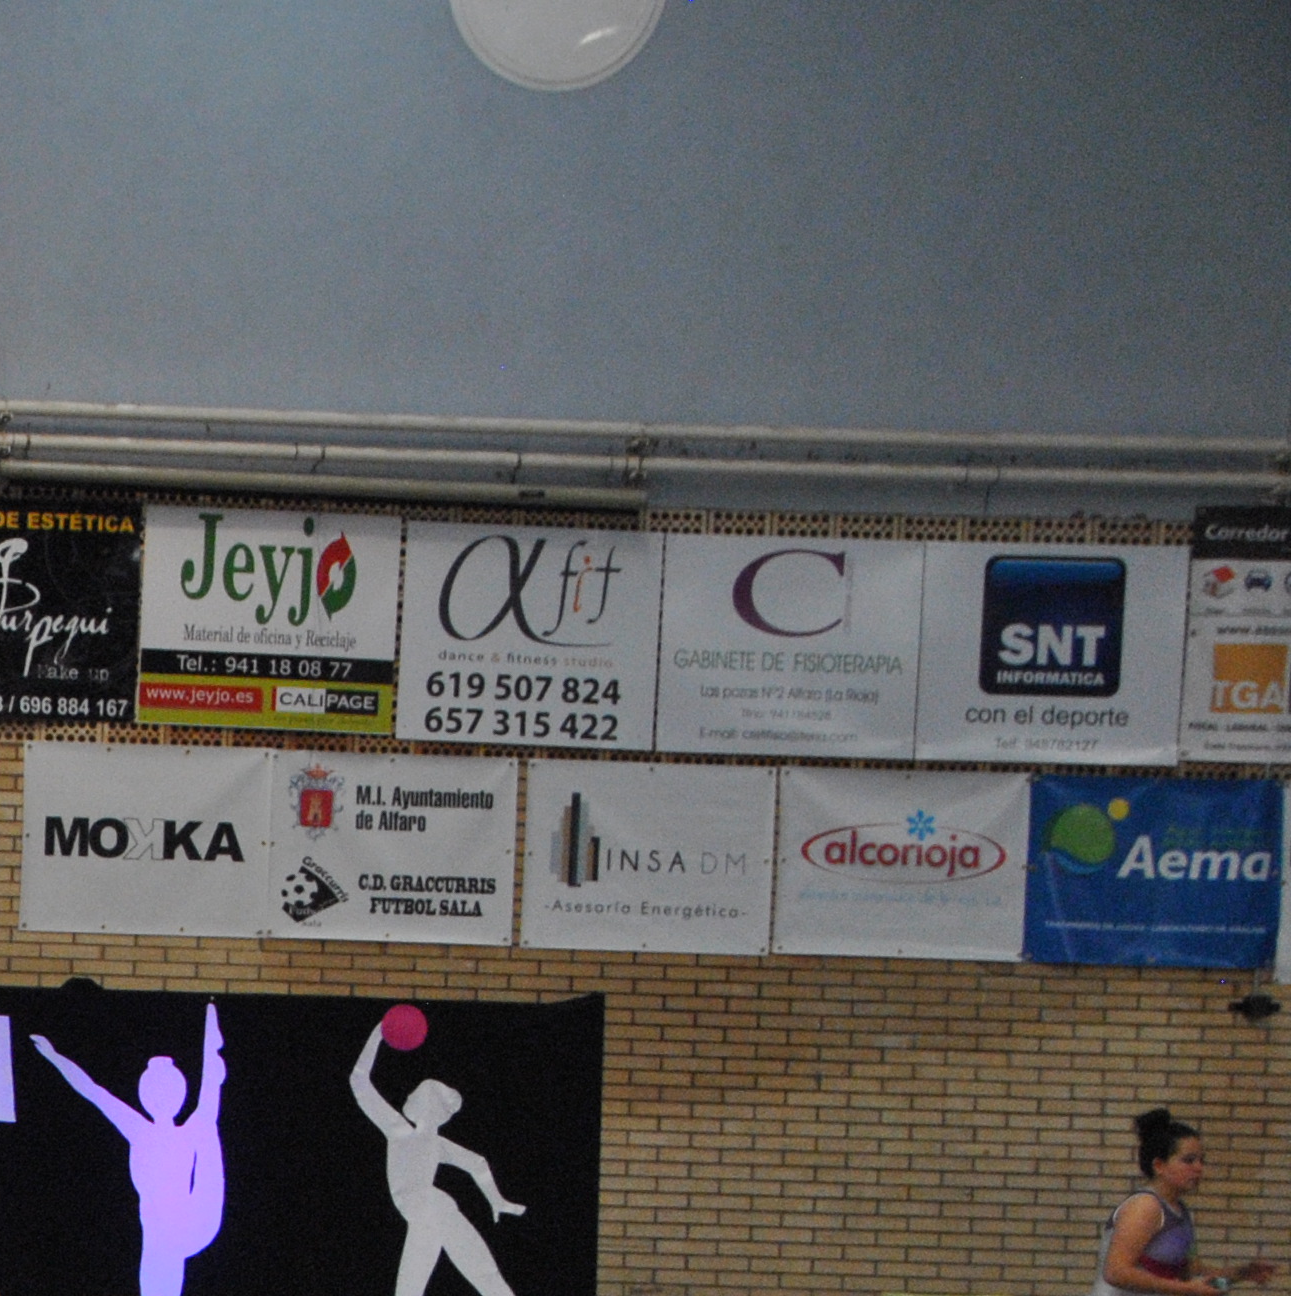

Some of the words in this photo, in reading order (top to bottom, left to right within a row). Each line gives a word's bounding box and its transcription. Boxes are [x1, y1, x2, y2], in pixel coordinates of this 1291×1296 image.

[27, 506, 135, 533] ESTÉTICA
[181, 512, 357, 627] Jeyjo
[183, 623, 235, 643] Material
[237, 625, 252, 644] de
[253, 626, 293, 647] oficina
[295, 633, 302, 650] y
[305, 629, 358, 653] Reciclaje
[999, 622, 1106, 667] SNT
[177, 655, 217, 672] Tel.:
[225, 657, 259, 674] 941
[270, 659, 291, 675] 18
[298, 660, 321, 676] 08
[330, 662, 352, 678] 77
[437, 649, 485, 663] dance
[490, 652, 501, 664] &
[506, 651, 558, 667] fitness
[564, 656, 614, 669] studio
[672, 648, 756, 672] GABINETE
[761, 651, 785, 672] DE
[793, 651, 904, 676] FISIOTERAPIA
[88, 668, 110, 682] up
[426, 671, 486, 699] 619
[494, 673, 554, 703] 507
[560, 675, 622, 706] 824
[996, 671, 1104, 685] INFORMATICA
[19, 696, 53, 714] 696
[57, 698, 90, 716] 884
[96, 698, 128, 717] 167
[145, 686, 254, 705] www.jeyjo.es
[1211, 680, 1285, 709] TGA
[424, 706, 484, 735] 657
[492, 708, 552, 739] 315
[559, 712, 619, 742] 422
[964, 706, 1007, 725] con
[1013, 704, 1035, 726] el
[1040, 704, 1130, 731] deporte
[355, 785, 387, 806] M.I.
[391, 786, 494, 810] Ayuntamiento
[355, 810, 373, 831] de
[378, 810, 427, 832] Alfaro
[606, 848, 687, 873] INSA
[700, 851, 747, 876] DM
[823, 828, 981, 878] alcorioja
[1115, 833, 1273, 883] Aema
[358, 873, 387, 891] C.D.
[390, 874, 497, 895] GRACCURRIS
[369, 896, 437, 916] FUTBOL
[439, 899, 483, 917] SALA
